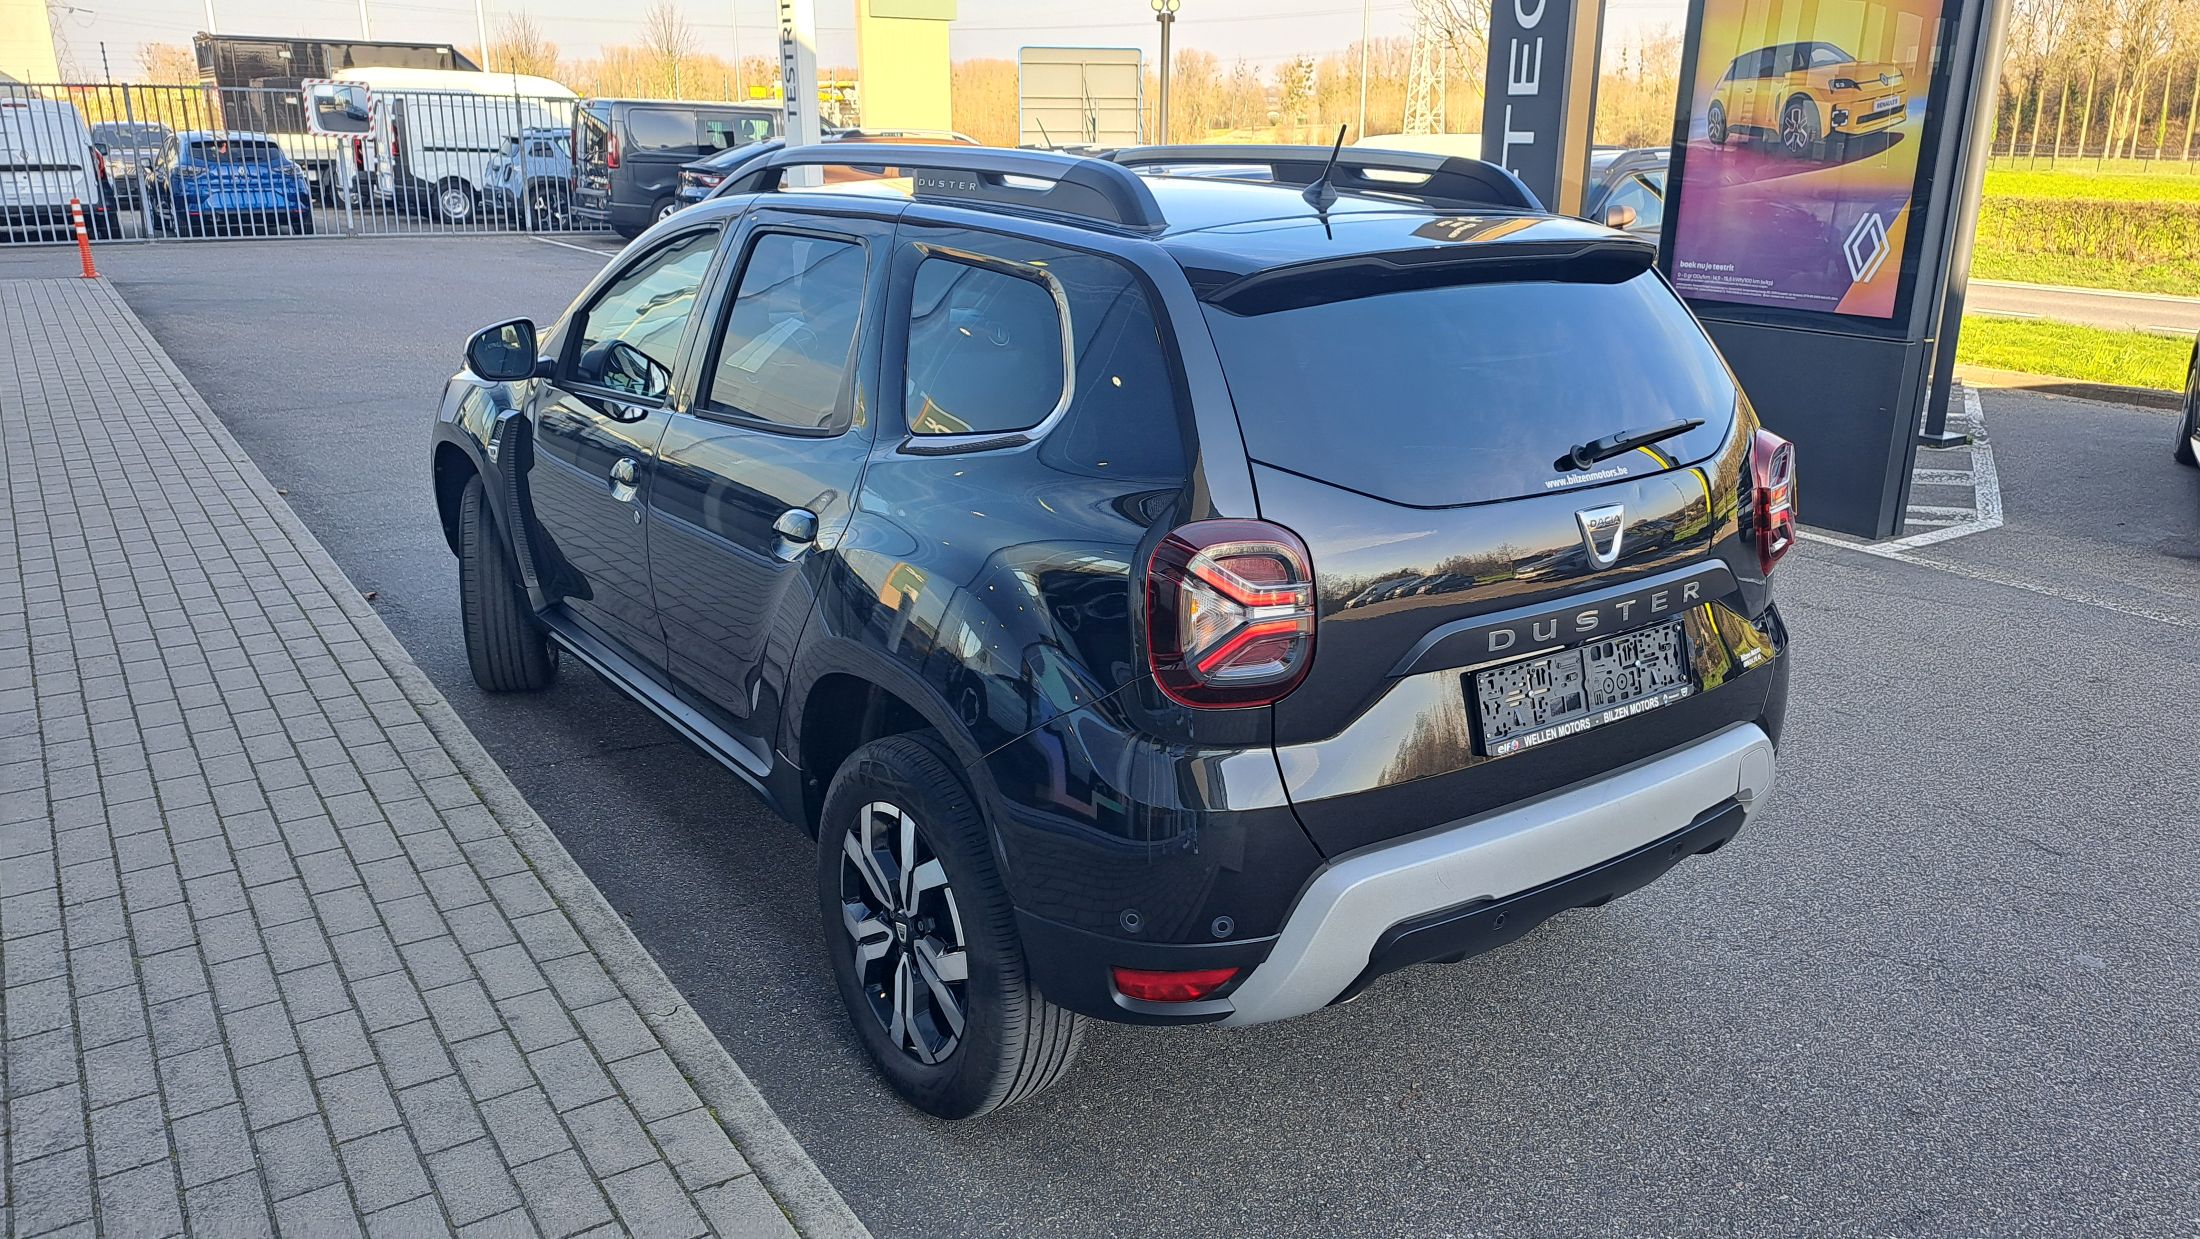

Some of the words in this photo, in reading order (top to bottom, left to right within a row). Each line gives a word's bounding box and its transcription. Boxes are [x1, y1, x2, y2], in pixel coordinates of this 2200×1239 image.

[918, 178, 977, 191] DUSTER
[1680, 260, 1696, 268] boek
[1712, 263, 1735, 272] testrit
[1545, 466, 1628, 489] www.bilzenmotors.be
[1589, 514, 1621, 528] DACIA
[1488, 581, 1700, 652] DUSTER
[1498, 742, 1512, 754] elf
[1524, 726, 1557, 748] WELLEN
[1558, 718, 1591, 738] MOTORS
[1603, 704, 1629, 723] BILZEN
[1630, 697, 1659, 714] MOTORS
